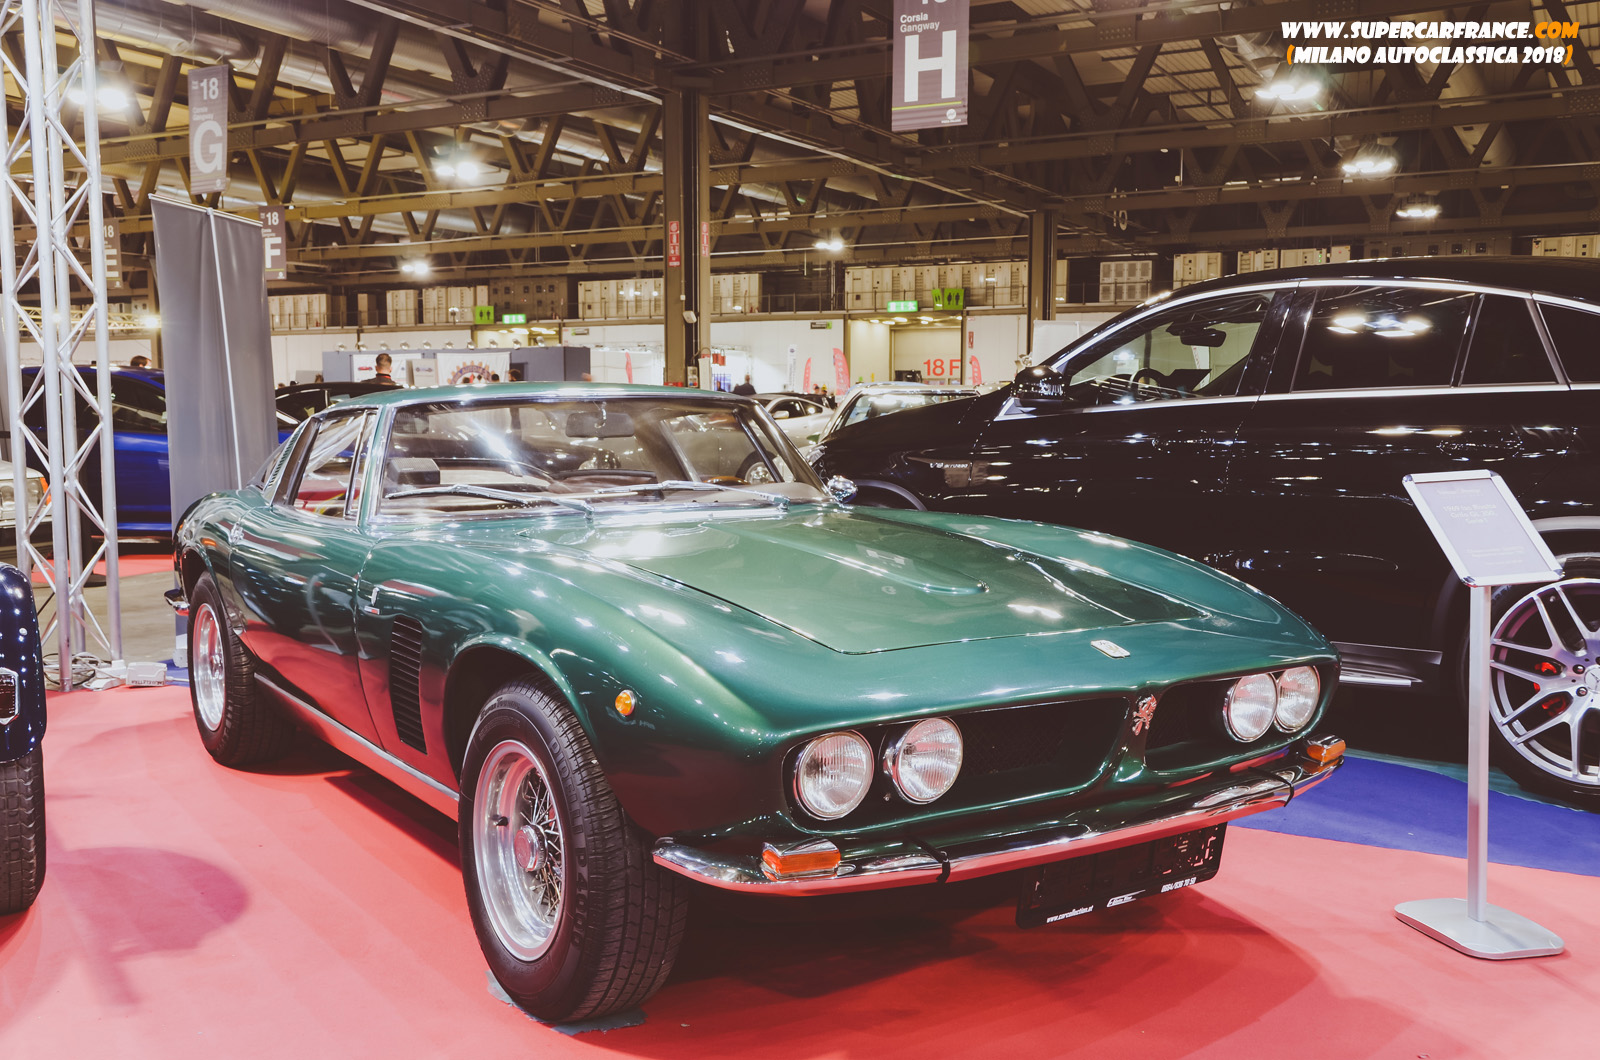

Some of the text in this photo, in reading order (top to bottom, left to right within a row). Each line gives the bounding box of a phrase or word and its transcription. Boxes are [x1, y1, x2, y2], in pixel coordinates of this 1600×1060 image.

[900, 12, 929, 23] Corsia
[900, 21, 940, 33] Gangway
[904, 30, 957, 103] H
[199, 77, 219, 101] 18
[193, 120, 223, 174] G
[265, 211, 280, 226] 18
[105, 248, 120, 278] E
[264, 237, 282, 269] F
[923, 358, 945, 377] 18
[949, 358, 962, 376] F
